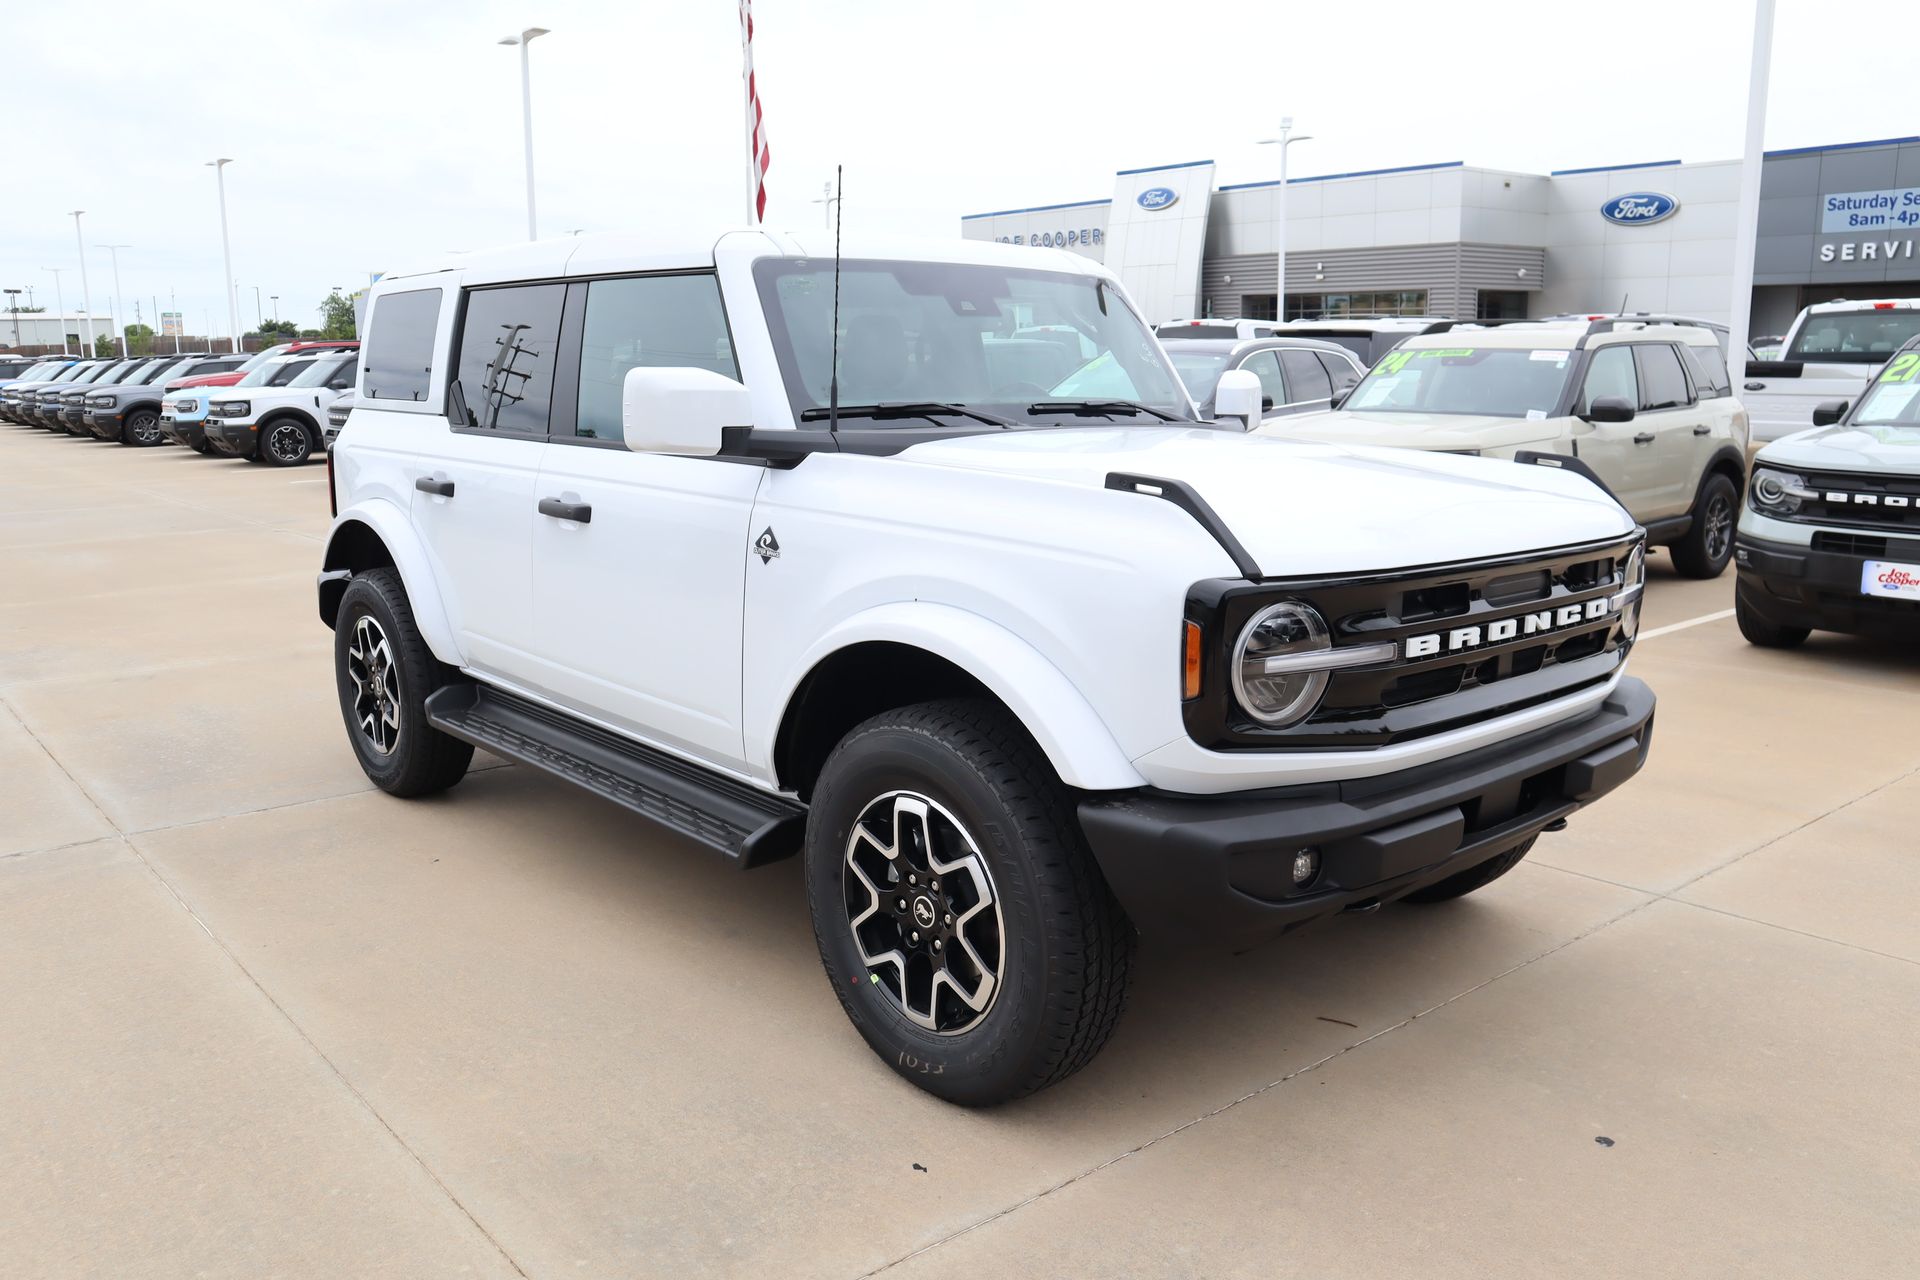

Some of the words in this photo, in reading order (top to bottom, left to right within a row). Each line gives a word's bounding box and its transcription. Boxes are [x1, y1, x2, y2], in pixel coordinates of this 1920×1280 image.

[1143, 191, 1167, 205] Ford
[1827, 194, 1898, 211] Saturday
[1903, 192, 1920, 206] Se
[1614, 198, 1659, 218] Ford
[1848, 213, 1885, 226] 8am
[1897, 210, 1920, 226] 4p
[1030, 228, 1102, 247] COOPER
[1820, 240, 1920, 262] SERVI
[1372, 352, 1415, 375] 24
[1826, 491, 1920, 508] BRO
[1878, 573, 1920, 586] Cooper
[1888, 568, 1910, 578] Joe
[1405, 598, 1608, 659] BRONCO
